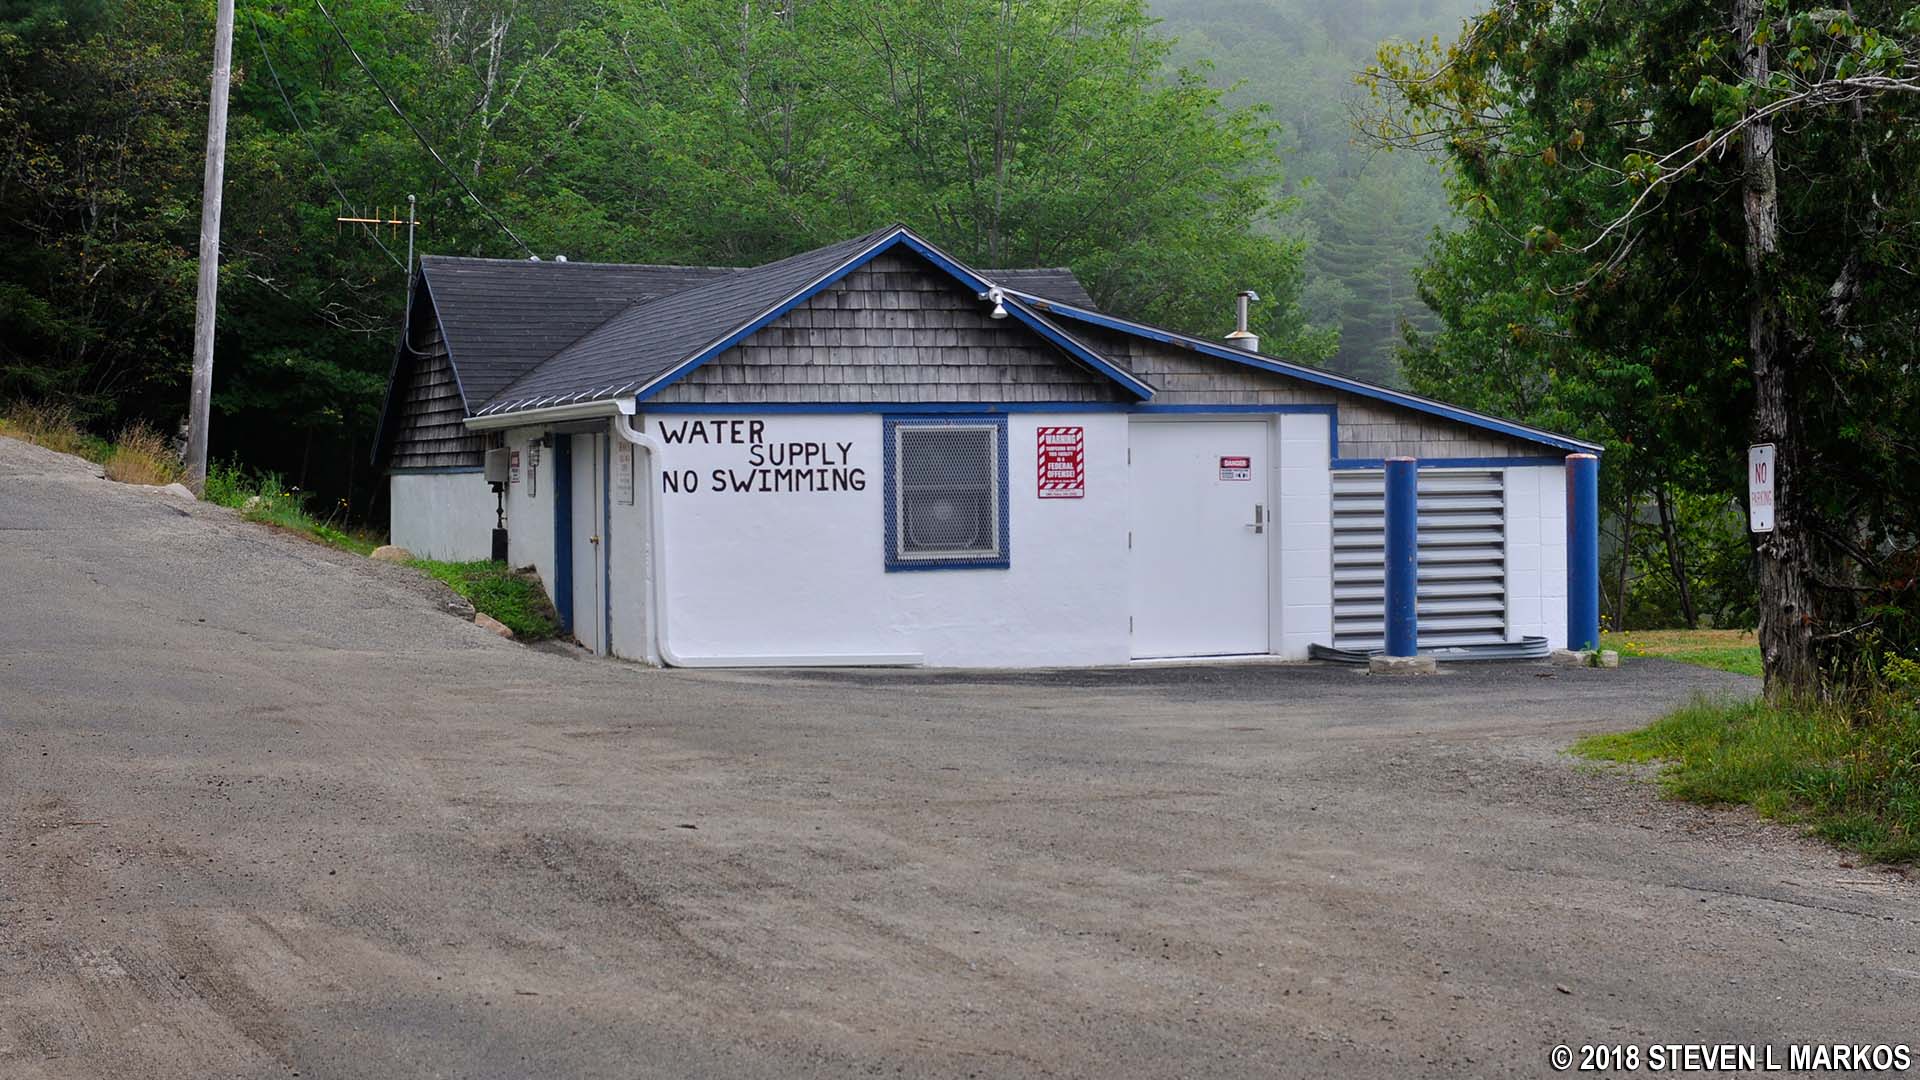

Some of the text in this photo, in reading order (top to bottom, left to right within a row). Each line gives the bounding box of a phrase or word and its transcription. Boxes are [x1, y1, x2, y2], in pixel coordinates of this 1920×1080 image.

[658, 420, 765, 444] WATER
[1045, 434, 1076, 444] WARNING
[748, 442, 853, 467] SUPPLY
[1047, 462, 1074, 470] FEDERAL
[1047, 470, 1075, 478] OFFENSE
[1755, 462, 1767, 485] NO
[662, 468, 866, 494] NO SWIMMING
[1751, 490, 1772, 506] PARKING
